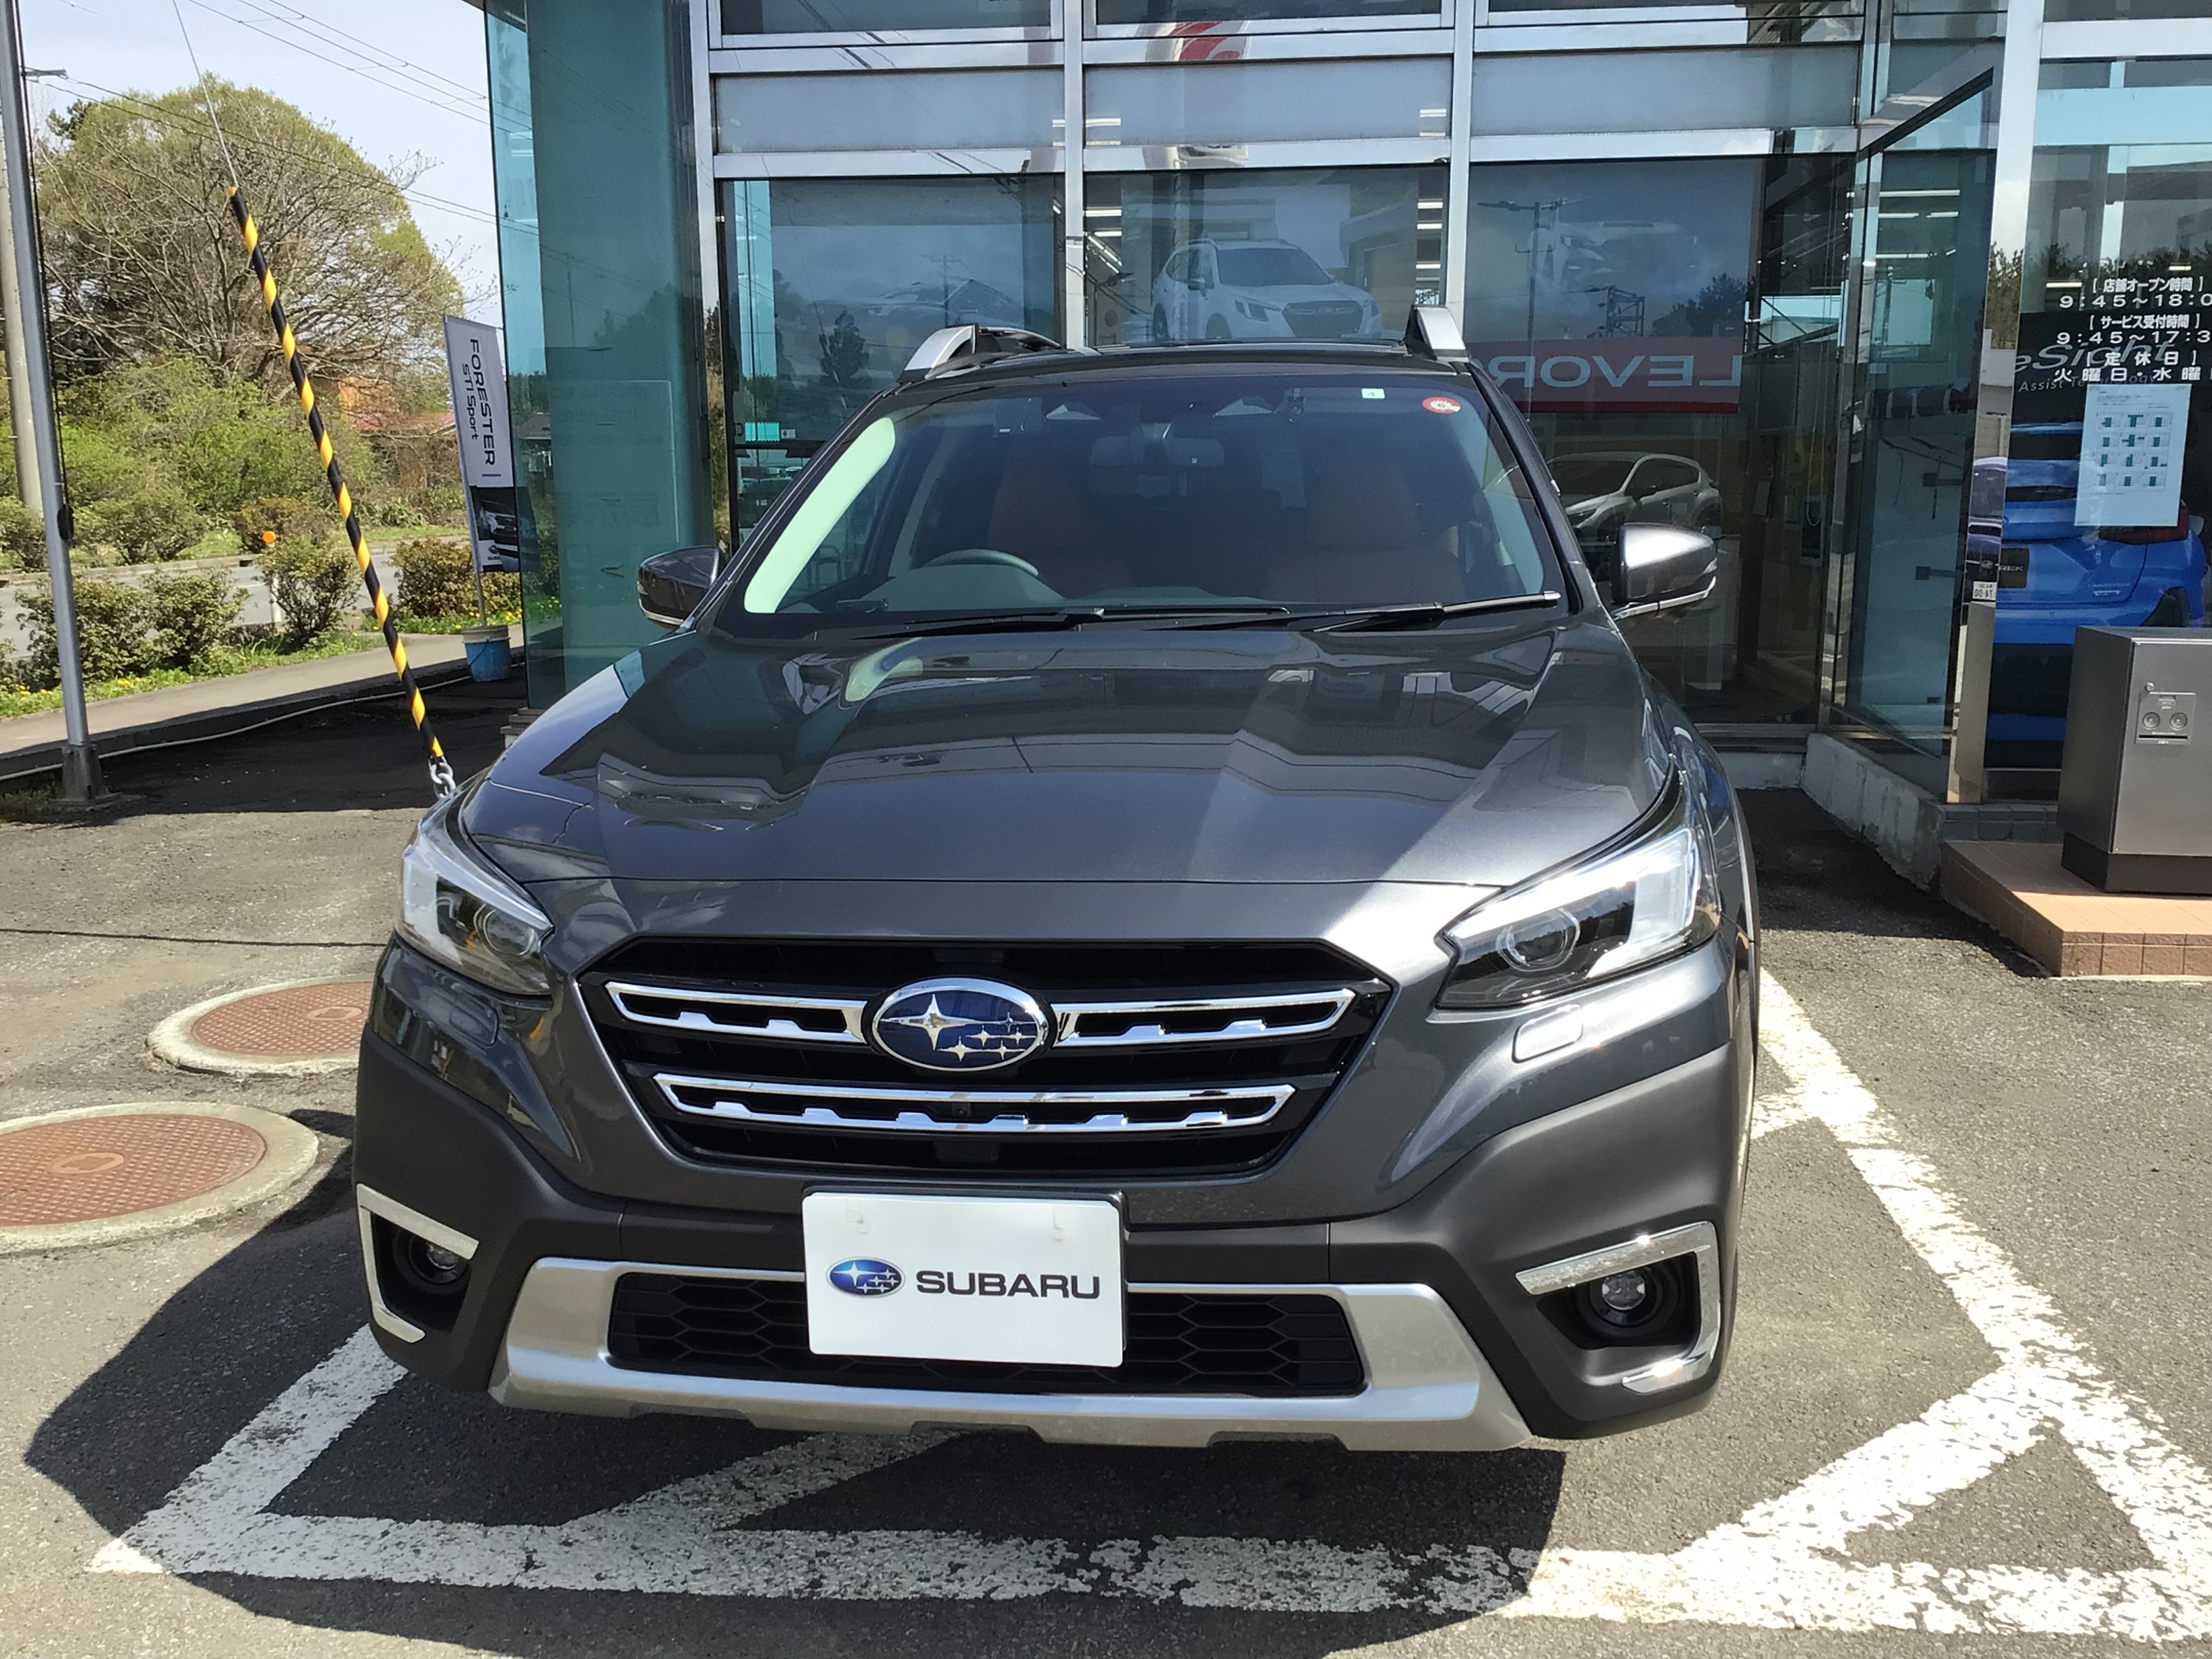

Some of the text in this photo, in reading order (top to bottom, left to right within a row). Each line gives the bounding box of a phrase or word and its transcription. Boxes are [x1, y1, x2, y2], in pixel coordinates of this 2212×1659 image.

[2053, 367, 2212, 382] 火曜日・水曜
[462, 363, 479, 441] STI Sport
[470, 338, 495, 466] FORESTER
[916, 1269, 1101, 1300] SUBARU
